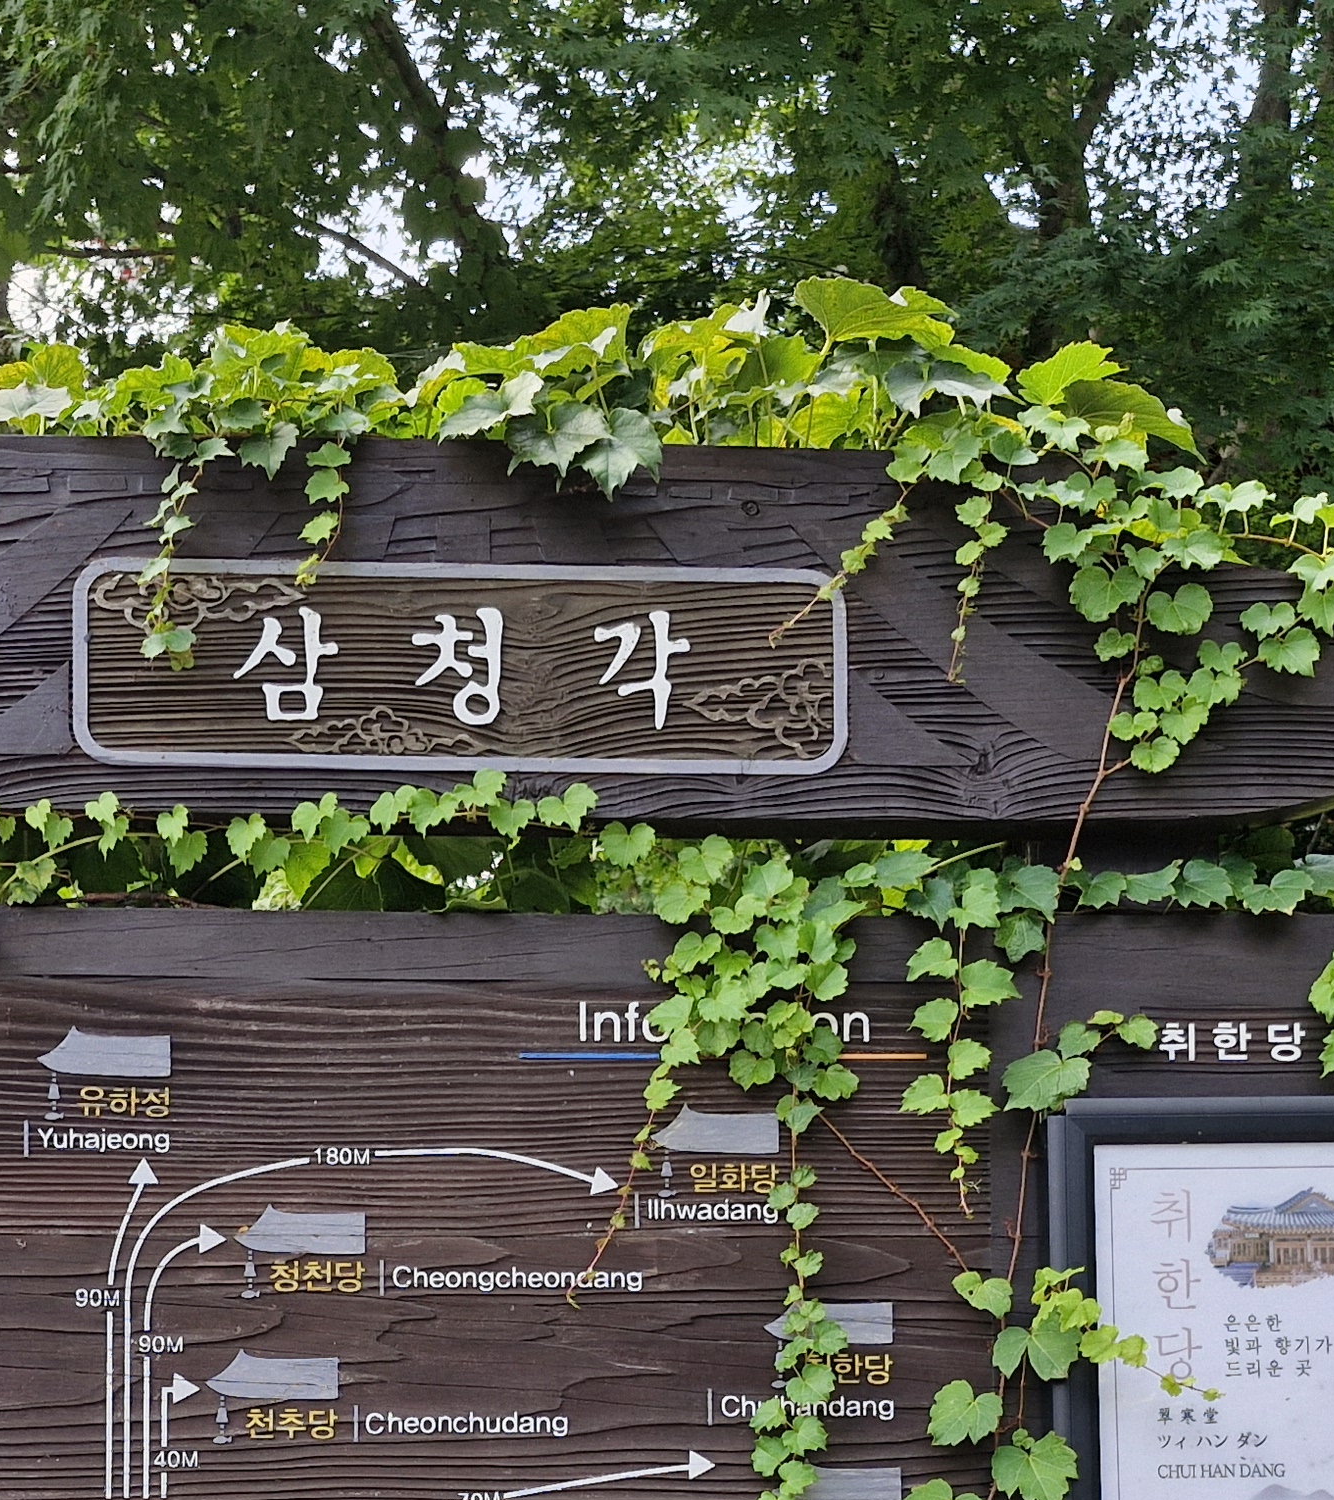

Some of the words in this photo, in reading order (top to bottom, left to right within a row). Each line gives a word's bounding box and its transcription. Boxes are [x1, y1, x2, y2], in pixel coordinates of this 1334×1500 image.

[234, 605, 690, 729] 삼청각
[579, 1002, 870, 1043] Infoon
[1159, 1022, 1305, 1061] 취한당
[75, 1085, 171, 1119] 유하정
[38, 1124, 170, 1153] Yuhajeong
[313, 1146, 371, 1167] 180M
[689, 1162, 781, 1195] 일화당
[648, 1196, 782, 1223] Ilhwadang
[269, 1260, 365, 1293] 청천당
[393, 1262, 642, 1295] Cheongcheondang
[1151, 1187, 1203, 1382] 취한당
[74, 1287, 120, 1308] 90M
[1224, 1314, 1282, 1332] 은은한
[137, 1334, 185, 1355] 90M
[1225, 1337, 1262, 1356] 빛과
[1275, 1336, 1332, 1355] 향기가
[1226, 1359, 1283, 1378] 드리운
[1296, 1359, 1311, 1376] 곳
[720, 1394, 896, 1421] Chhandang
[245, 1407, 338, 1440] 천추당
[366, 1411, 568, 1436] Cheonchudang
[153, 1450, 199, 1469] 40M
[1158, 1464, 1196, 1479] CHUI
[1201, 1464, 1235, 1478] HAN
[1240, 1464, 1286, 1479] DANG
